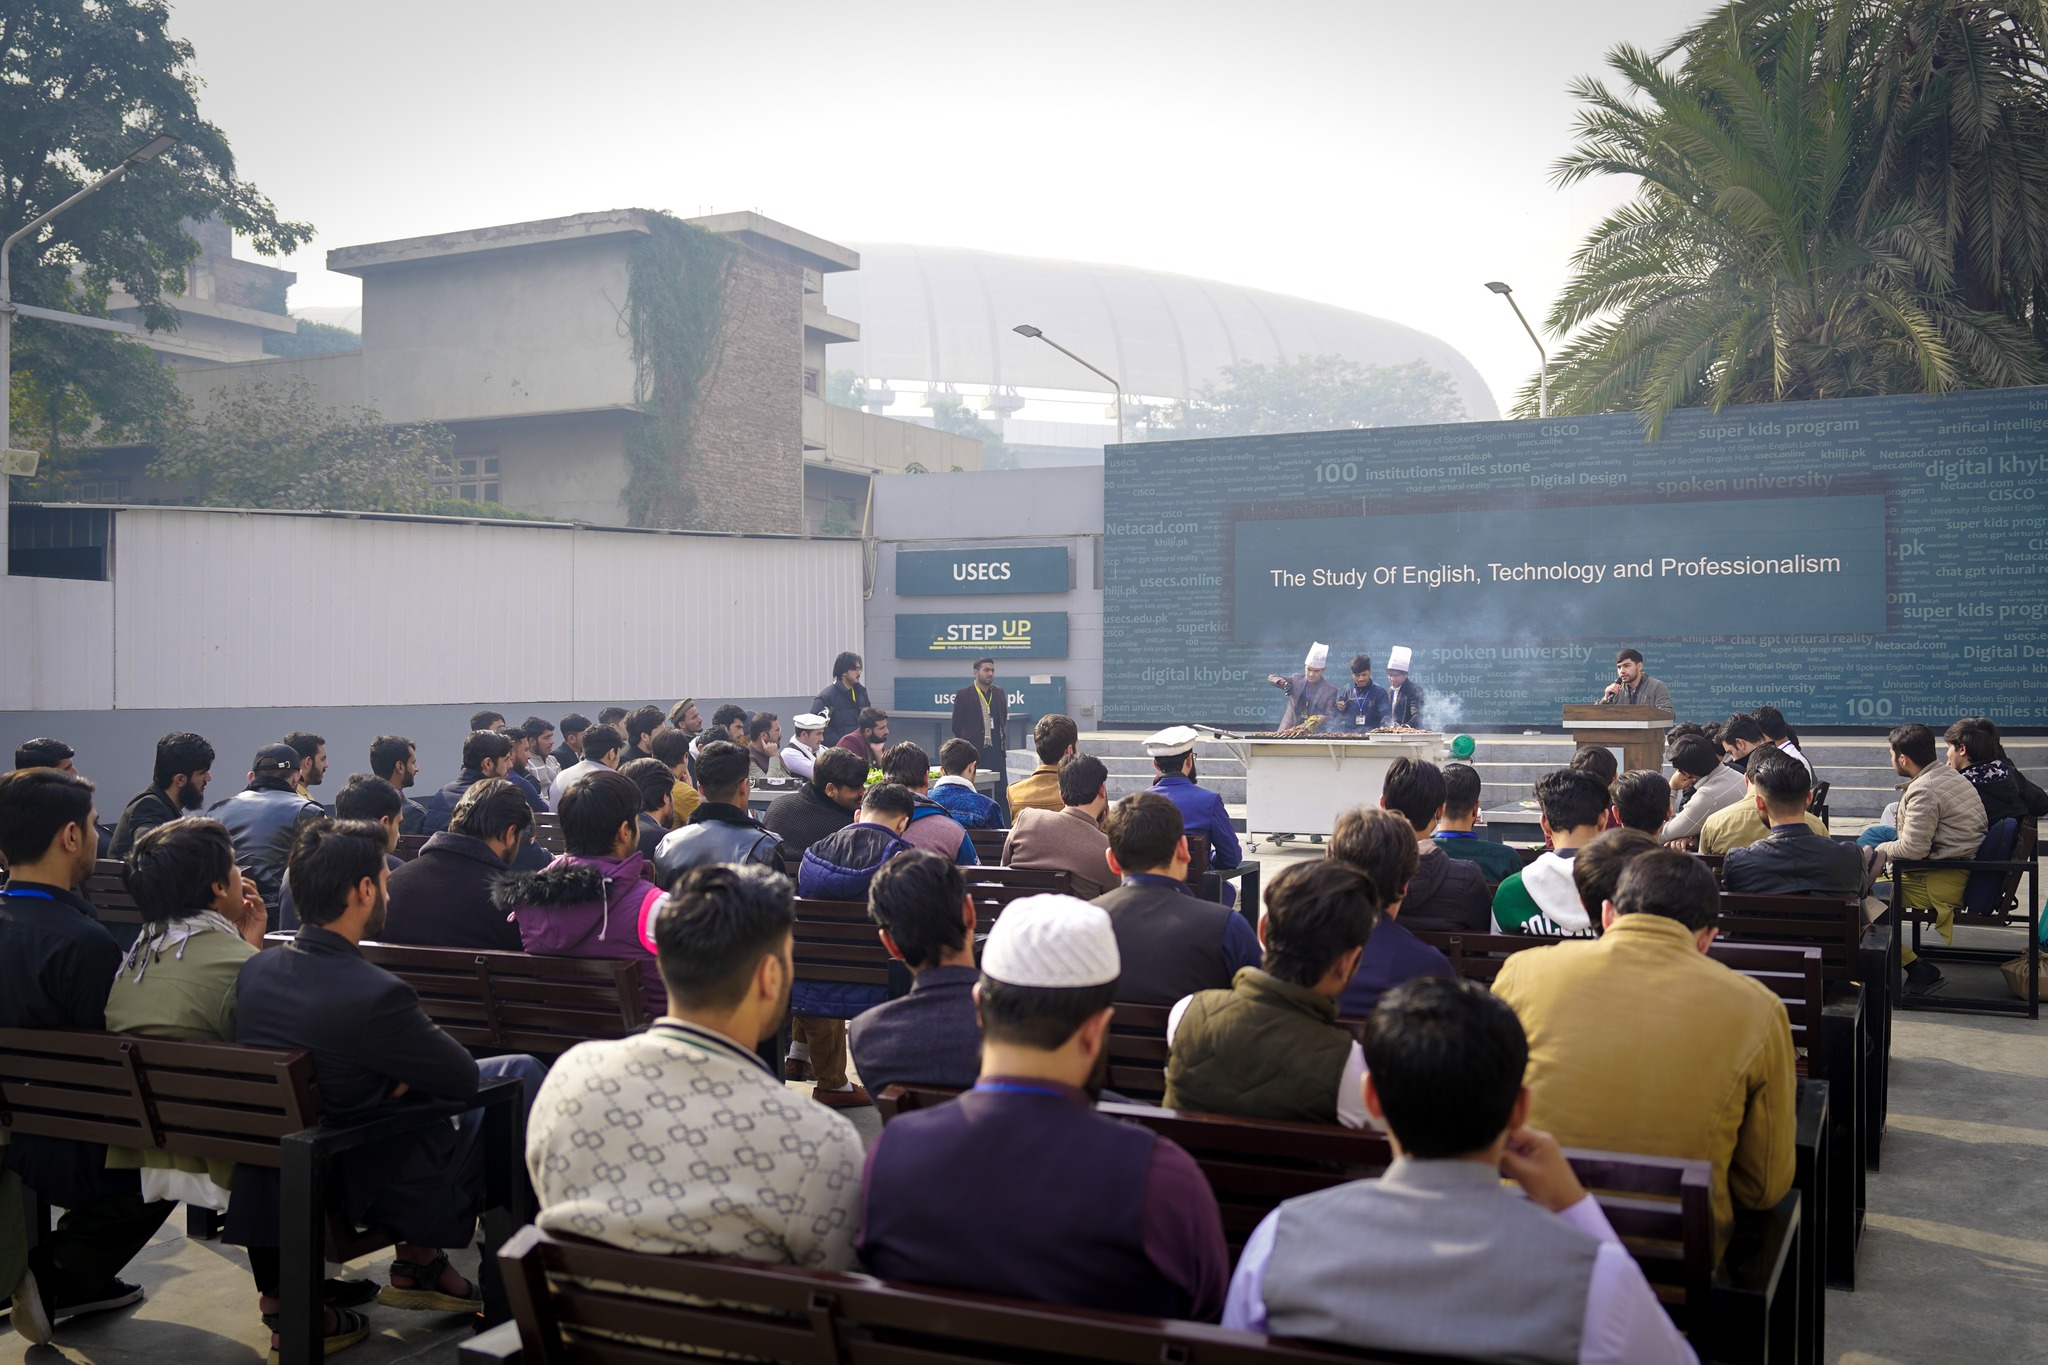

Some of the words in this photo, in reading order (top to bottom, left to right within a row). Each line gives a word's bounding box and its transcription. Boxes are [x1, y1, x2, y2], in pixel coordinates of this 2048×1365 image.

[1540, 424, 1580, 437] CISCO
[1698, 426, 1744, 442] super
[1748, 421, 1781, 437] kids
[1786, 420, 1860, 438] program
[1938, 420, 1990, 435] artifical
[1394, 438, 1432, 446] University
[1476, 433, 1506, 443] English
[1689, 446, 1726, 454] University
[1738, 444, 1767, 452] Spoken
[1769, 442, 1798, 452] English
[1880, 448, 1951, 460] Netacad.com
[1956, 446, 1988, 457] CISCO
[1180, 456, 1195, 464] Chat
[1208, 454, 1233, 462] virtural
[1234, 452, 1256, 461] reality
[1438, 452, 1493, 463] usecs.edu.pk
[1754, 450, 1806, 460] usecs.online
[1820, 448, 1866, 461] khilji.pk
[1109, 458, 1137, 466] usecs
[1632, 459, 1667, 468] University
[1678, 457, 1704, 466] Spoken
[1706, 456, 1732, 464] English
[1872, 460, 1927, 470] usecs.online
[1314, 463, 1358, 483] 100
[1366, 465, 1445, 480] institutions
[1448, 462, 1486, 476] miles
[1490, 462, 1531, 474] stone
[1925, 457, 1992, 482] digital
[1530, 473, 1576, 490] Digital
[1580, 471, 1627, 487] Design
[1656, 476, 1727, 498] spoken
[1733, 470, 1834, 492] university
[1940, 480, 2014, 491] Netacad.com
[1132, 488, 1156, 496] CISCO
[1406, 484, 1422, 492] chat
[1422, 484, 1436, 494] gpt
[1437, 483, 1465, 491] virtural
[1466, 482, 1491, 492] reality
[1885, 488, 1925, 498] program
[1988, 488, 2036, 501] CISCO
[1162, 510, 1182, 518] CISCO
[1930, 507, 1970, 516] University
[1981, 504, 2013, 514] Spoken
[2014, 504, 2046, 514] English
[1106, 520, 1199, 536] Netacad.com
[1946, 520, 1981, 531] super
[1984, 517, 2009, 528] kids
[1968, 532, 1988, 540] chat
[1990, 531, 2006, 541] gpt
[2008, 530, 2044, 538] virtural
[1154, 536, 1189, 548] khilji.pk
[1176, 554, 1200, 562] reality
[953, 562, 1011, 581] USECS
[1270, 569, 1306, 587] The
[1312, 568, 1367, 590] Study
[1373, 566, 1397, 585] Of
[1403, 564, 1481, 588] English,
[1488, 562, 1607, 584] Technology
[1613, 559, 1653, 578] and
[1661, 554, 1841, 577] Professionalism
[1936, 566, 1962, 577] chat
[1964, 566, 1986, 580] gpt
[1989, 564, 2036, 577] virtural
[1140, 574, 1223, 588] usecs.online
[1932, 591, 1968, 600] University
[1978, 590, 2008, 598] Spoken
[2008, 589, 2036, 598] English
[1903, 606, 1954, 622] super
[1958, 602, 1994, 618] kids
[1104, 613, 1168, 626] usecs.edu.pk
[947, 624, 998, 641] STEP
[1002, 619, 1032, 637] UP
[1730, 635, 1756, 645] chat
[1760, 634, 1781, 648] gpt
[1784, 633, 1830, 644] virtural
[1832, 632, 1874, 646] reality
[1875, 640, 1948, 650] Netacad.com
[1432, 644, 1496, 664] spoken
[1502, 642, 1593, 663] university
[1810, 646, 1844, 654] program
[1964, 645, 2018, 662] Digital
[1450, 662, 1494, 670] usecs.edu.pk
[1720, 662, 1748, 671] khyber
[1748, 662, 1774, 670] Digital
[1776, 662, 1803, 671] Design
[1808, 664, 1845, 672] University
[1856, 664, 1885, 672] Spoken
[1886, 663, 1916, 672] English
[1916, 662, 1950, 670] Chakwal
[1974, 664, 2028, 674] usecs.edu.pk
[1141, 666, 1190, 686] digital
[1194, 666, 1248, 685] khyber
[1437, 672, 1482, 687] khyber
[1488, 670, 1532, 678] usecs.online
[1538, 676, 1586, 684] usecs.online
[1710, 683, 1753, 696] spoken
[1756, 682, 1816, 696] university
[1882, 680, 1930, 690] University
[1932, 680, 1942, 688] of
[1944, 680, 1981, 690] Spoken
[1984, 680, 2020, 691] English
[1459, 687, 1491, 698] miles
[1493, 688, 1528, 698] stone
[1732, 698, 1802, 708] usecs.online
[1900, 695, 1946, 705] University
[1948, 694, 1957, 702] of
[1959, 694, 1994, 704] Spoken
[1996, 694, 2030, 704] English
[1132, 702, 1176, 714] university
[1234, 706, 1266, 716] CISCO
[1484, 708, 1509, 716] khyber
[1846, 698, 1893, 717] 100
[1900, 704, 1986, 718] institutions
[1990, 704, 2030, 718] miles
